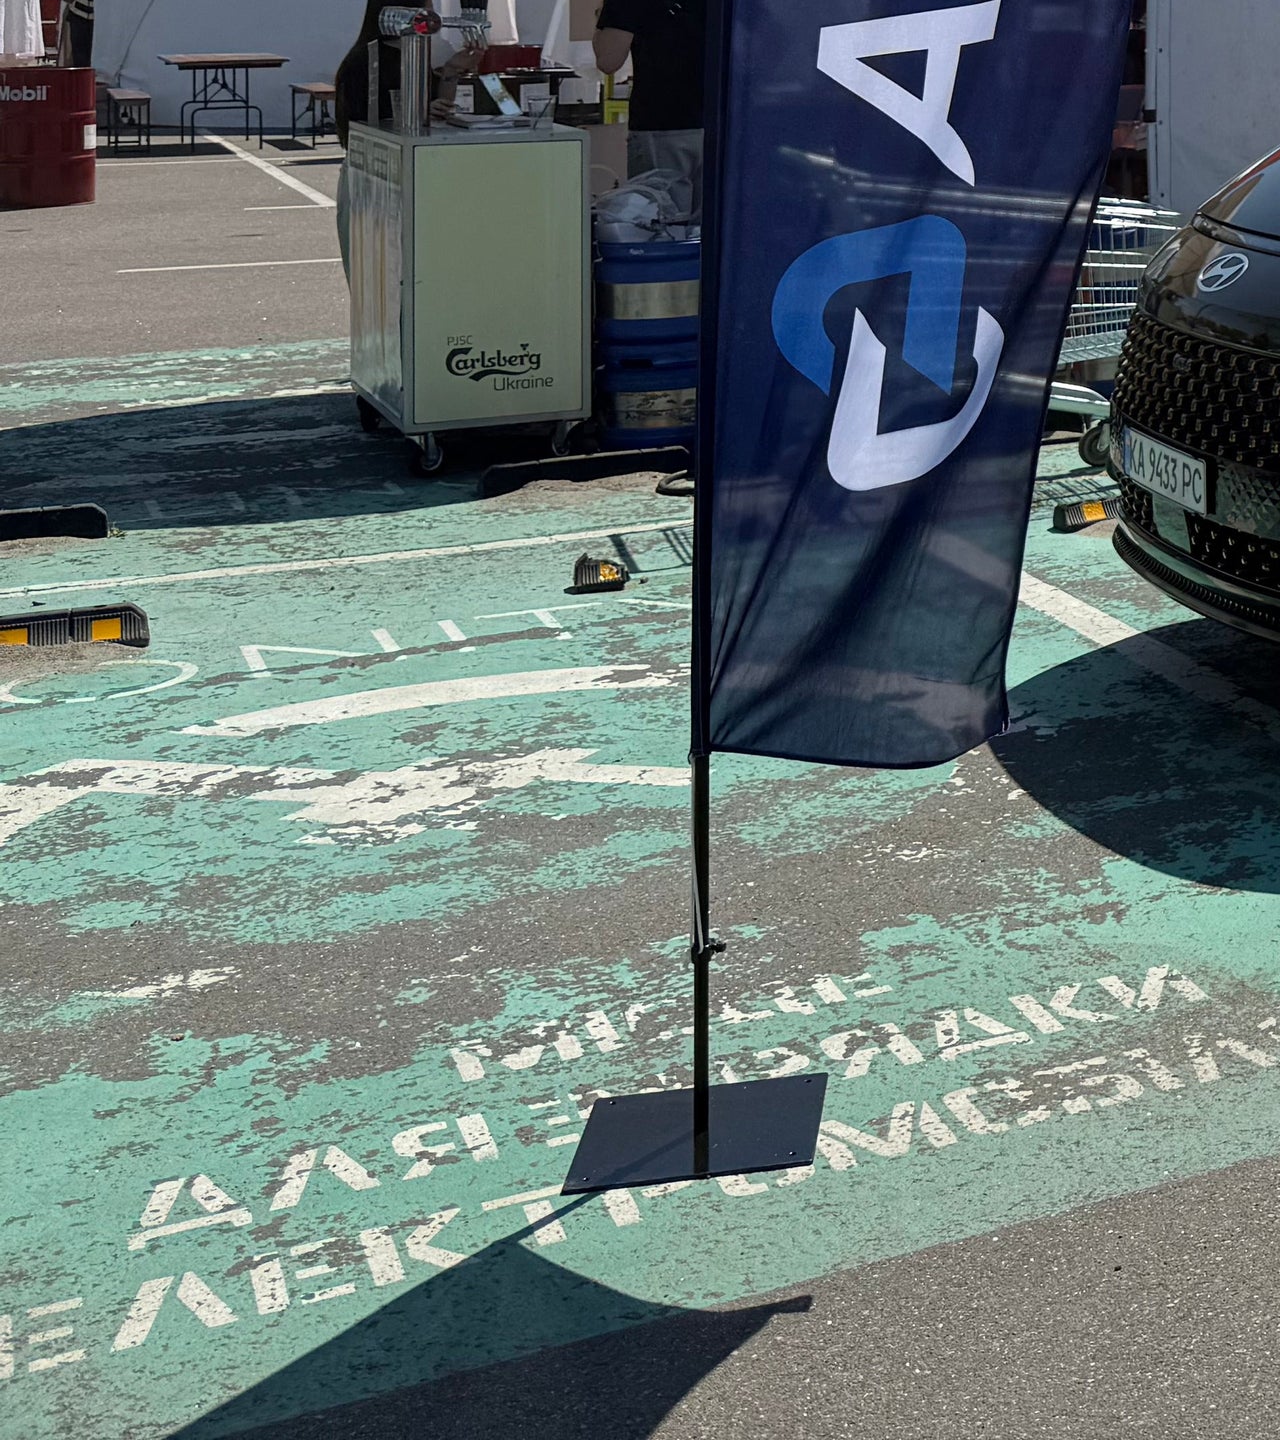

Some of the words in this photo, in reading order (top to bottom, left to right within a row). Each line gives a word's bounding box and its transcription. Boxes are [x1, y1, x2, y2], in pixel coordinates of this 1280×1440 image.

[447, 334, 473, 346] PJSC
[445, 346, 542, 377] Carlsberg
[493, 376, 554, 392] Ukraine
[1149, 447, 1178, 494] 9433
[1182, 461, 1202, 505] PC
